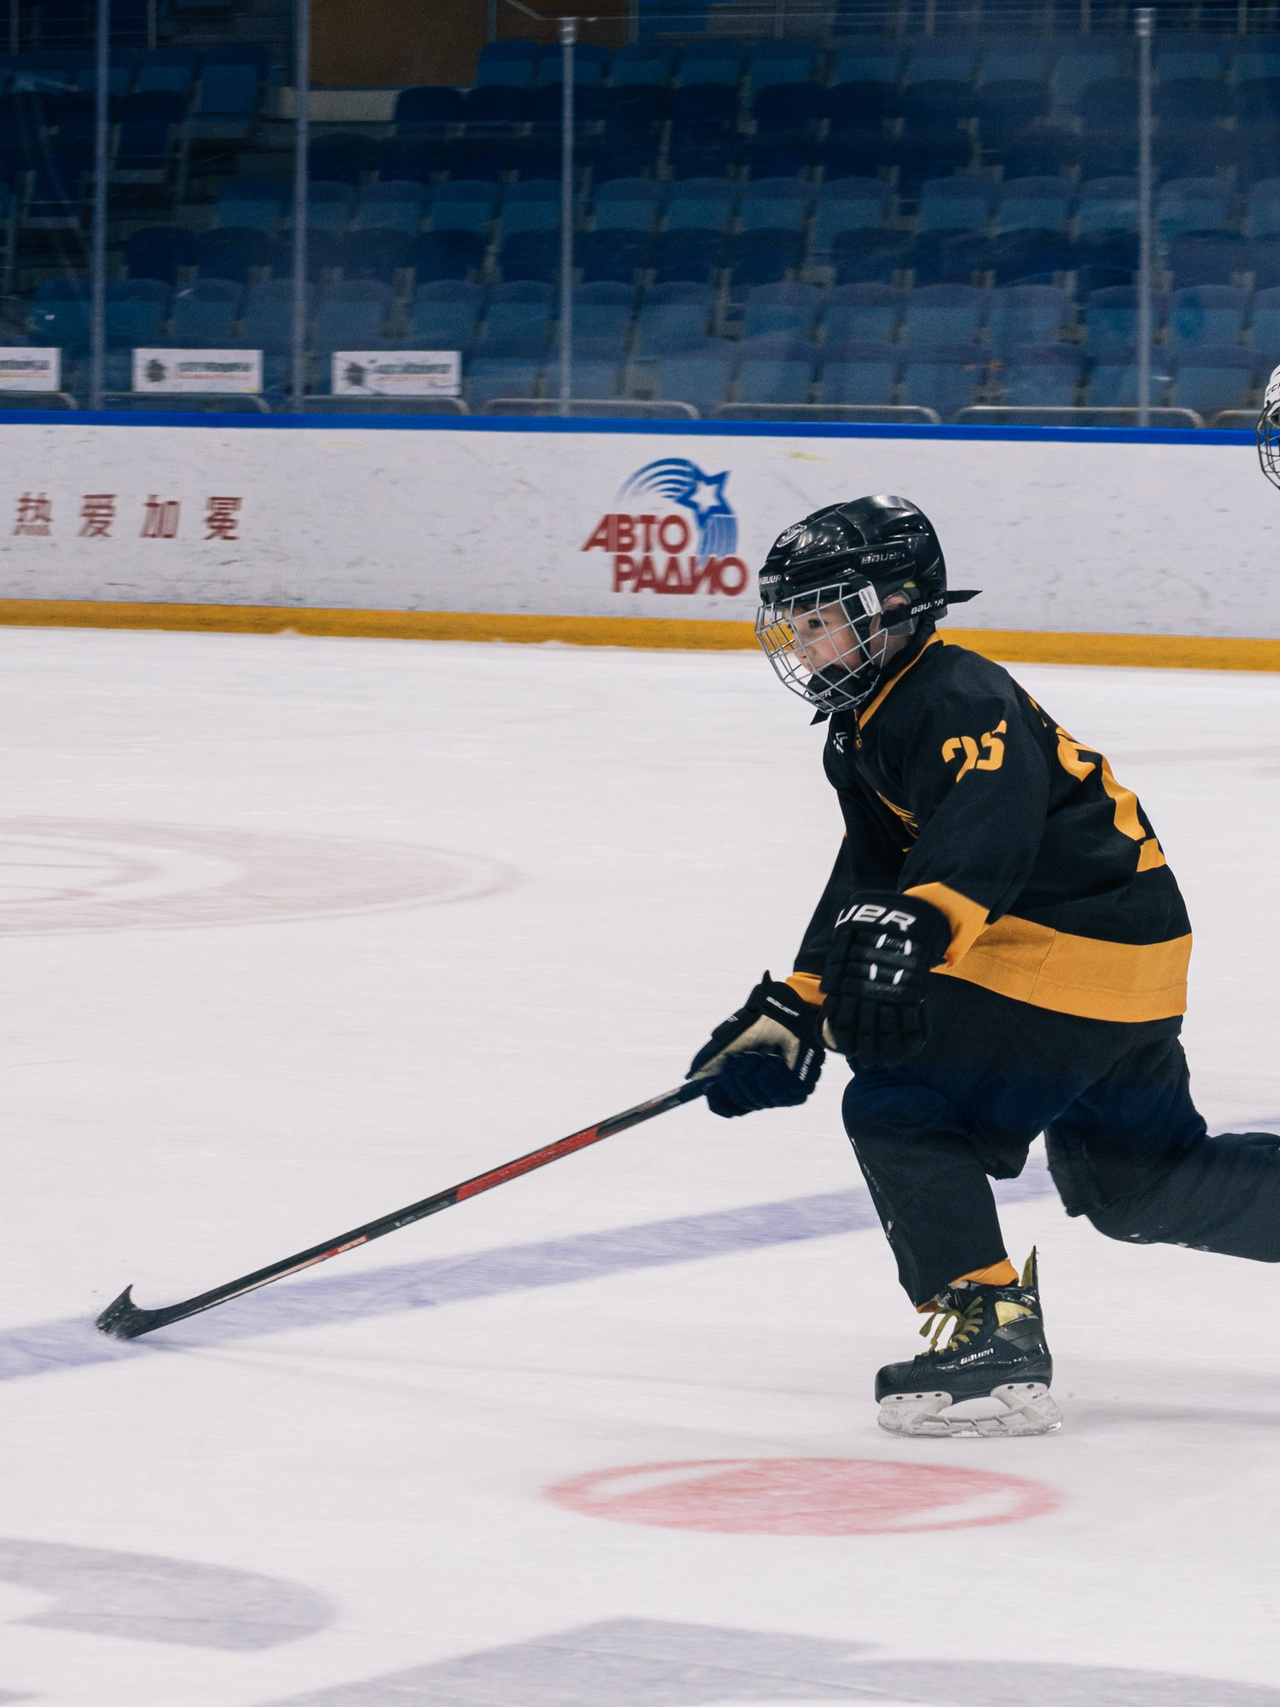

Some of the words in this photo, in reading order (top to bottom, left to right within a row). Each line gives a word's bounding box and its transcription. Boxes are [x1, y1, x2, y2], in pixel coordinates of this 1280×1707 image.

[580, 513, 690, 555] АВТО
[612, 554, 748, 597] РАДИО
[758, 574, 782, 586] AUER
[911, 598, 945, 616] BAUR
[941, 719, 1008, 784] 25
[834, 903, 917, 932] UER
